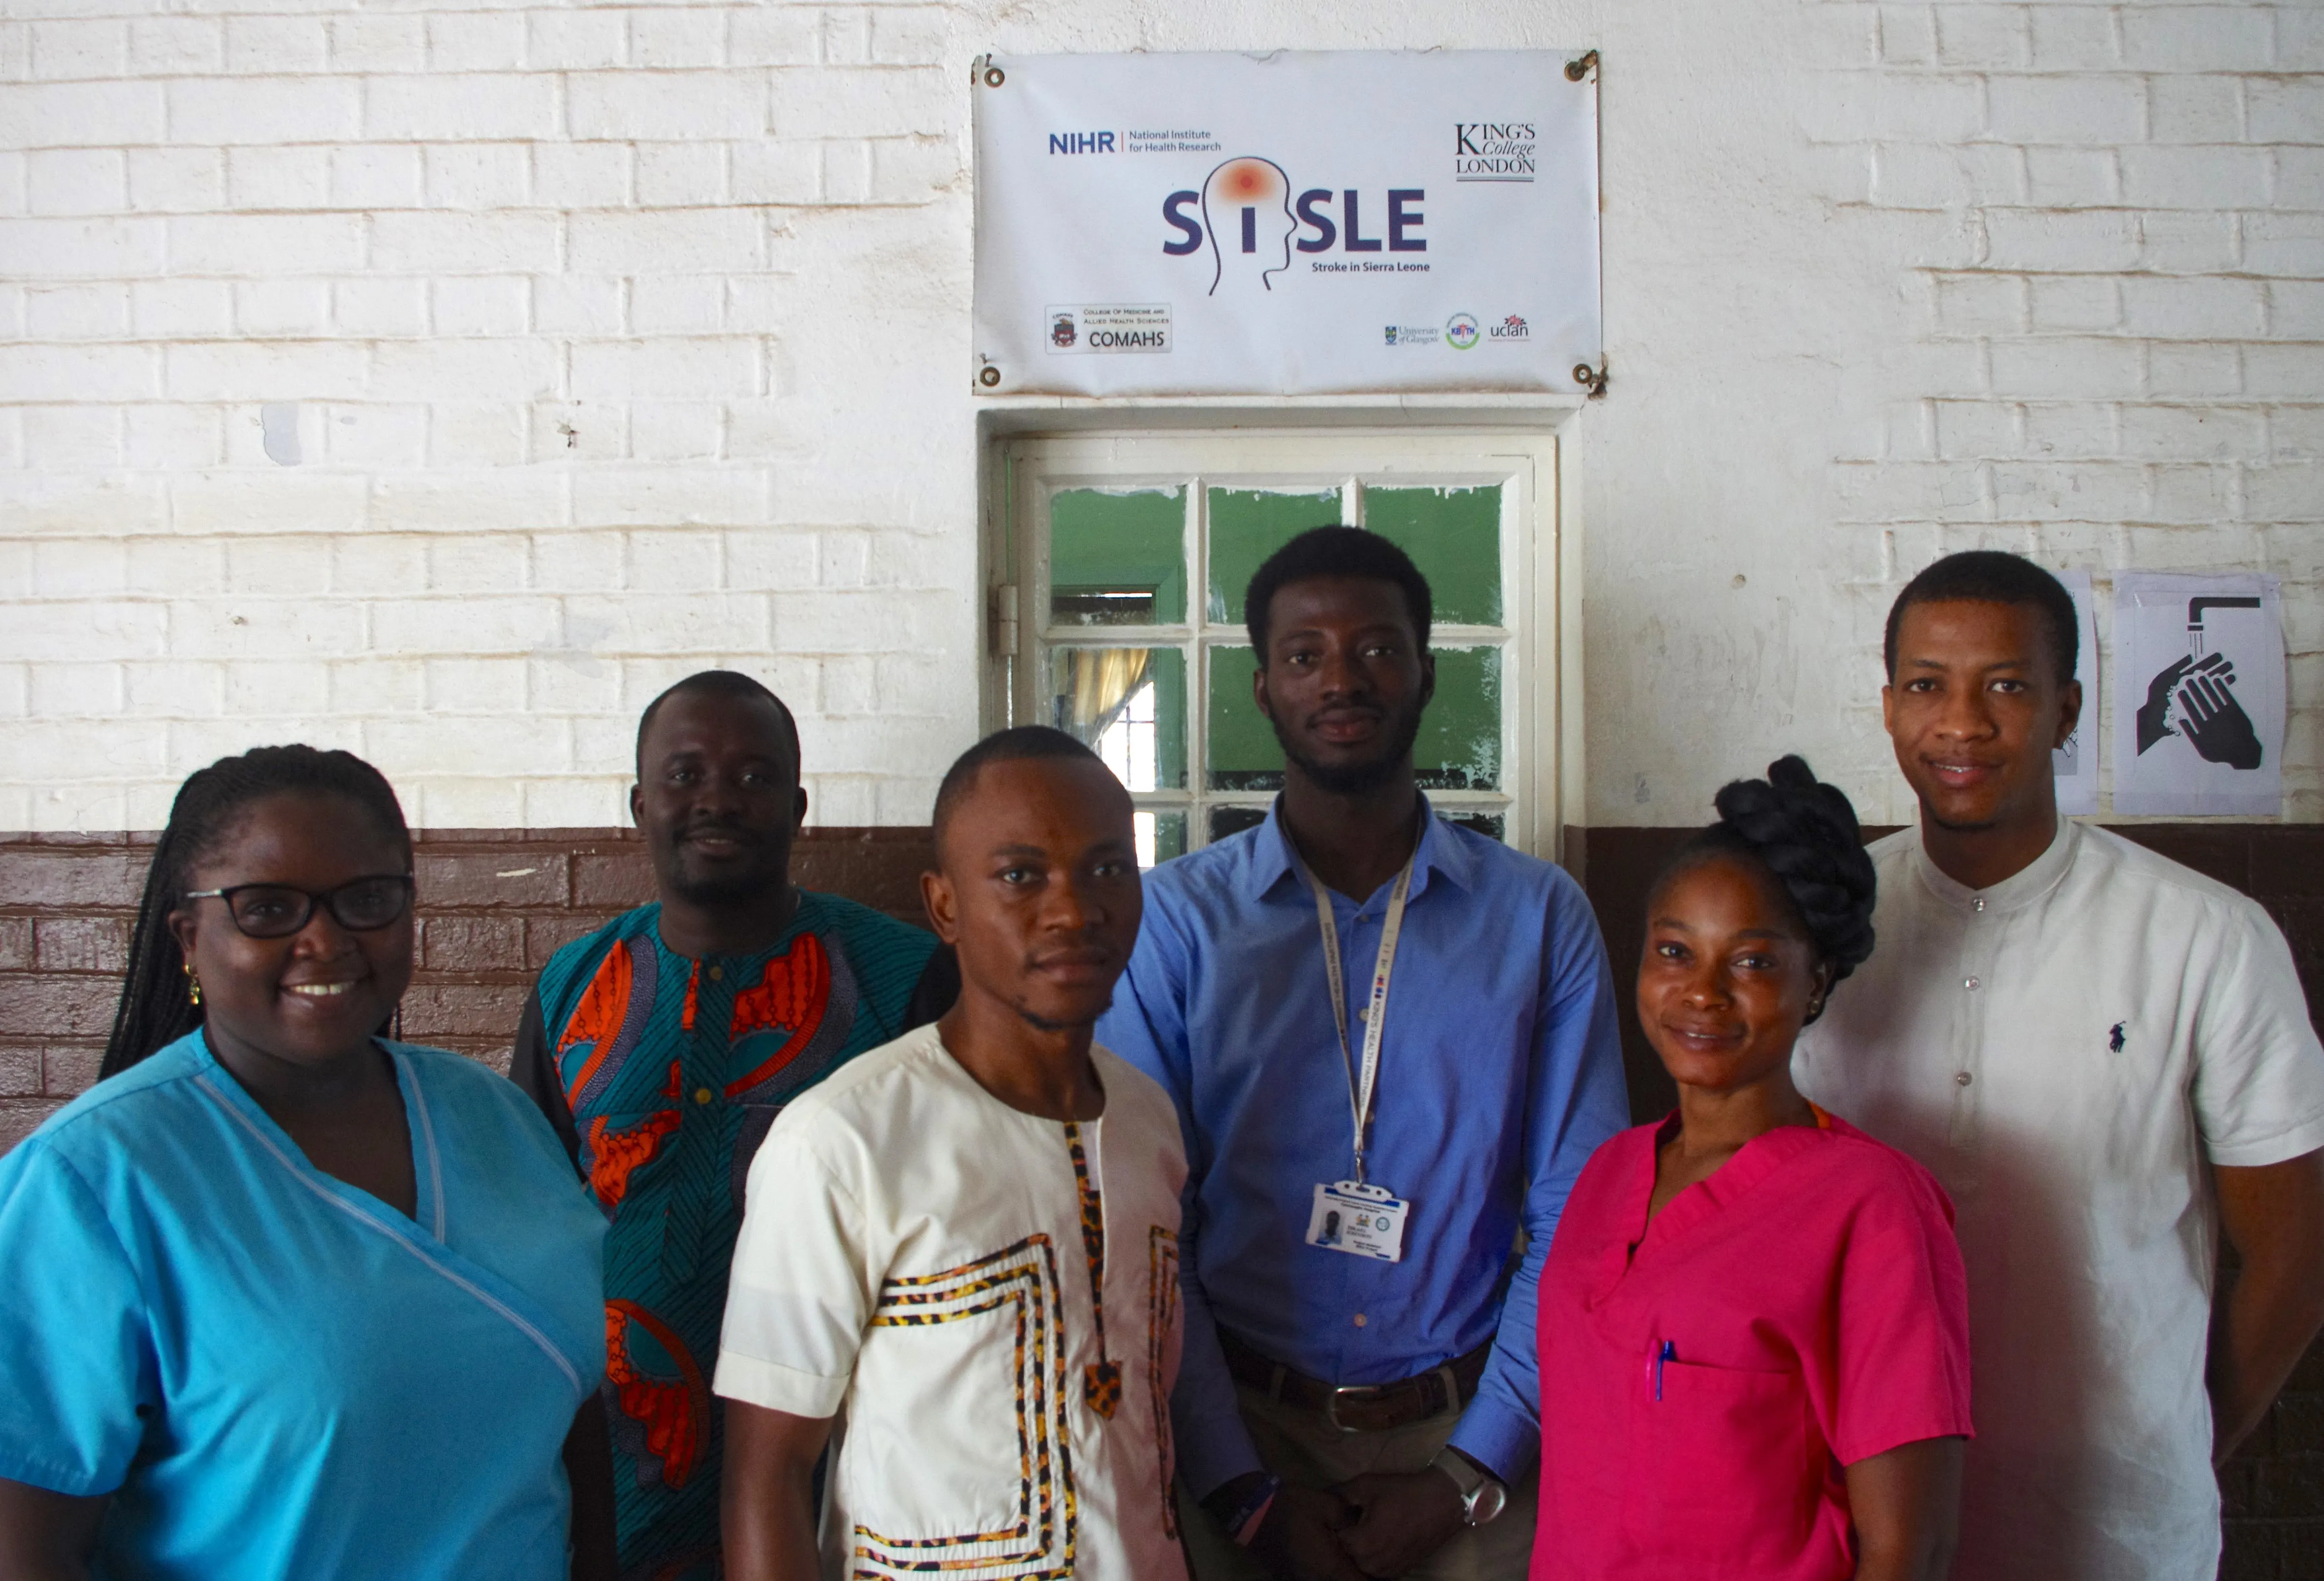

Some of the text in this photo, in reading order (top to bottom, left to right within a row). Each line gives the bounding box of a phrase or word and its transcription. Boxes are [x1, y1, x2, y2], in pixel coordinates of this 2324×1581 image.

[1129, 130, 1211, 140] National Institute
[1455, 124, 1535, 155] KING'S
[1050, 131, 1115, 154] NIHR
[1129, 142, 1221, 152] for Health Research
[1483, 141, 1535, 160] College
[1456, 159, 1535, 174] LONDON
[1312, 262, 1430, 273] Stroke in Sierra Leone
[1399, 326, 1439, 335] University
[1491, 325, 1528, 337] uclan
[1089, 332, 1164, 347] COMAHS
[1406, 336, 1439, 345] Glasgow
